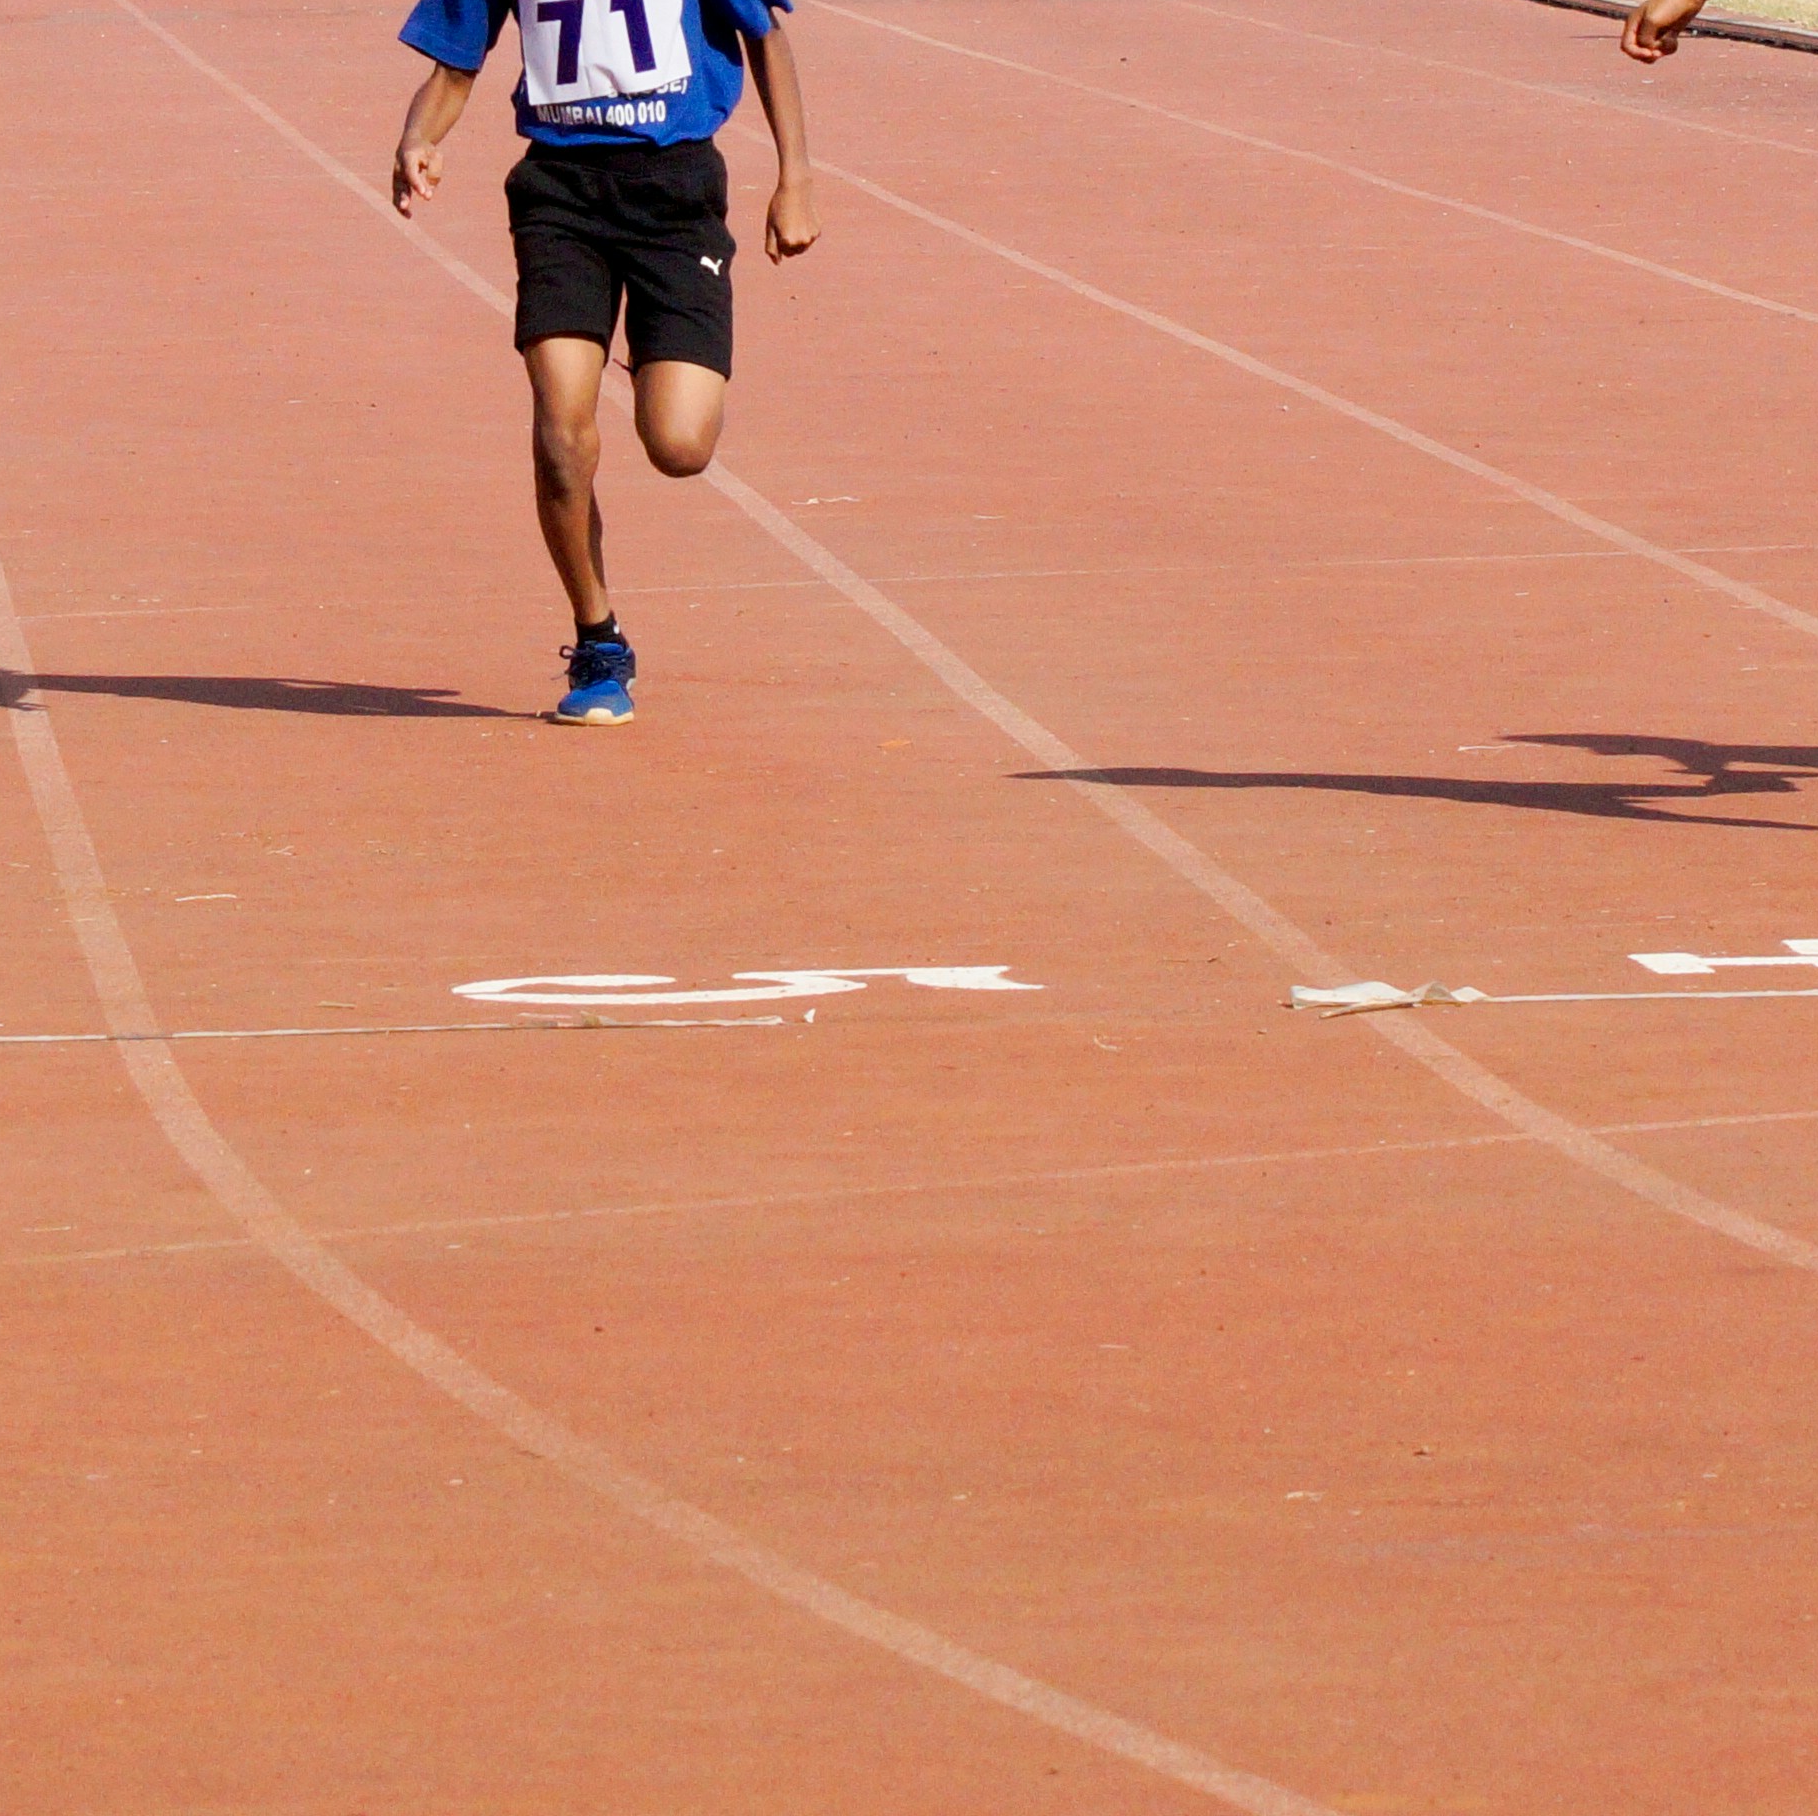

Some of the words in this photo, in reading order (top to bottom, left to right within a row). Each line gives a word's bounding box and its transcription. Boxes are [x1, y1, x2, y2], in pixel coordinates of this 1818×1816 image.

[536, 105, 603, 125] MUMBAI
[605, 103, 635, 126] 400
[638, 100, 666, 123] 010
